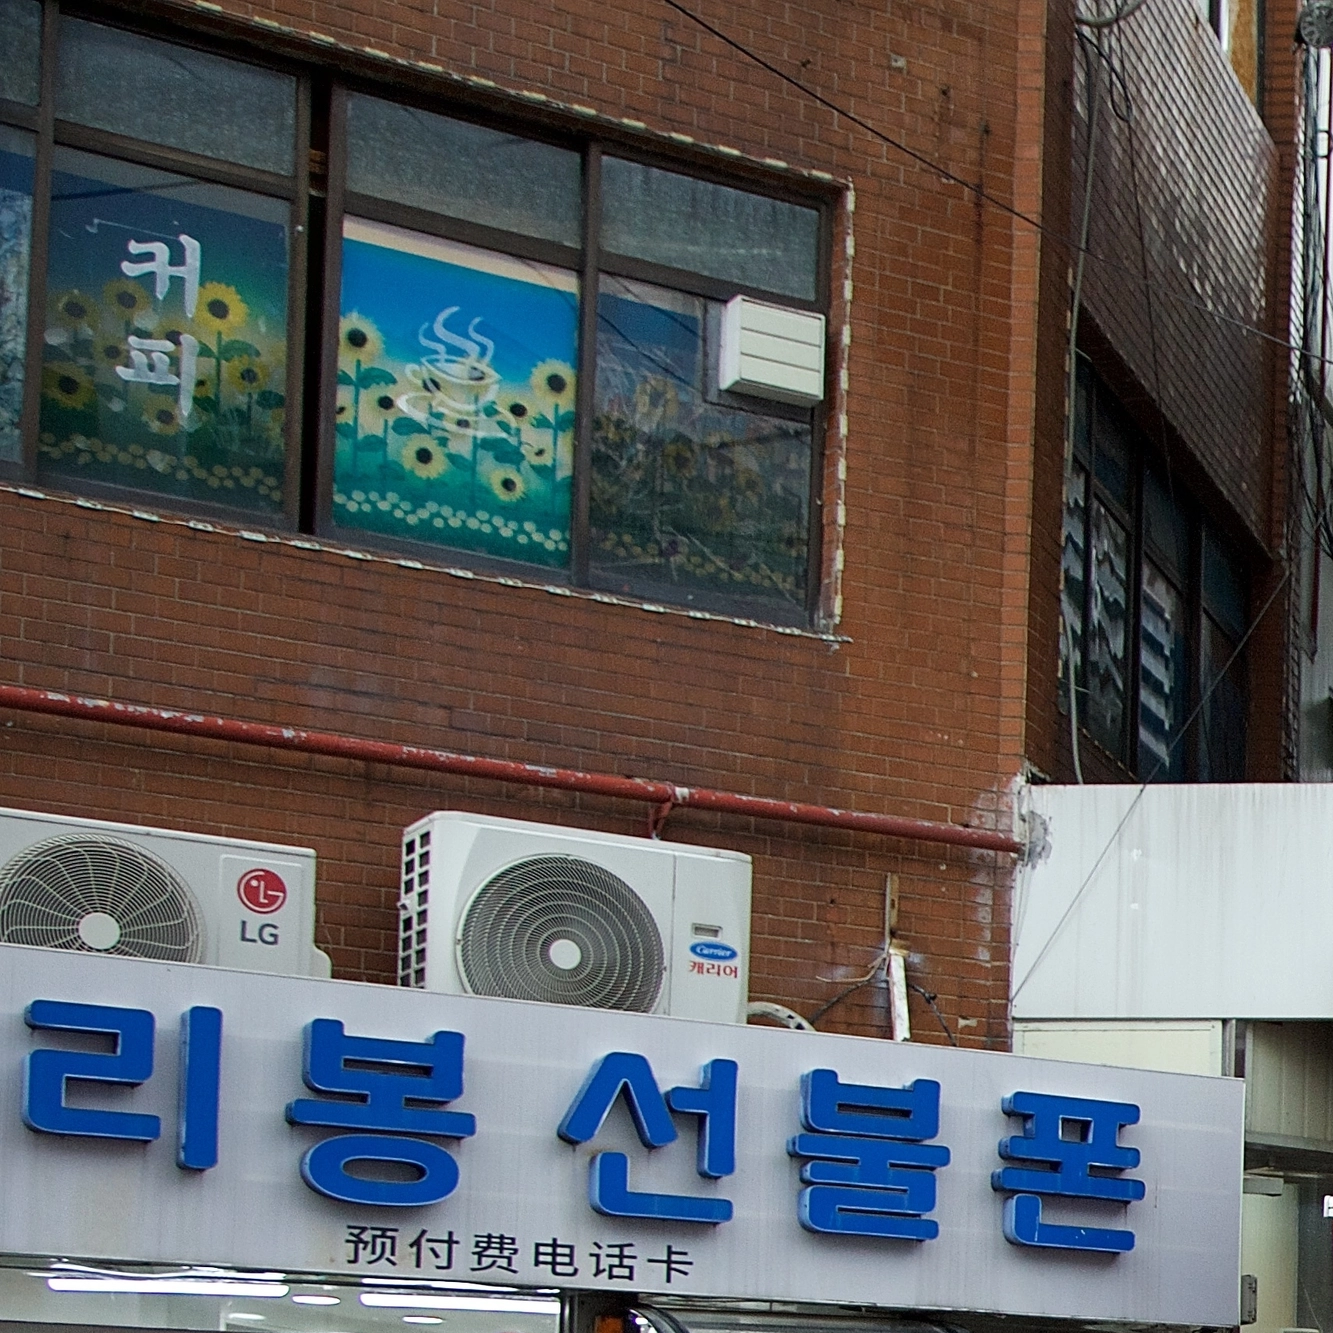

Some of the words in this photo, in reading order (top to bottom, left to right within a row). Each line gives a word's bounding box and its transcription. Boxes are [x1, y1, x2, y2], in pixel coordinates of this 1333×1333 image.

[116, 234, 200, 418] 커피
[240, 919, 280, 946] LG
[695, 943, 734, 958] Carrier
[688, 960, 739, 979] 캐리어
[344, 1223, 696, 1285] 预付费电话卡
